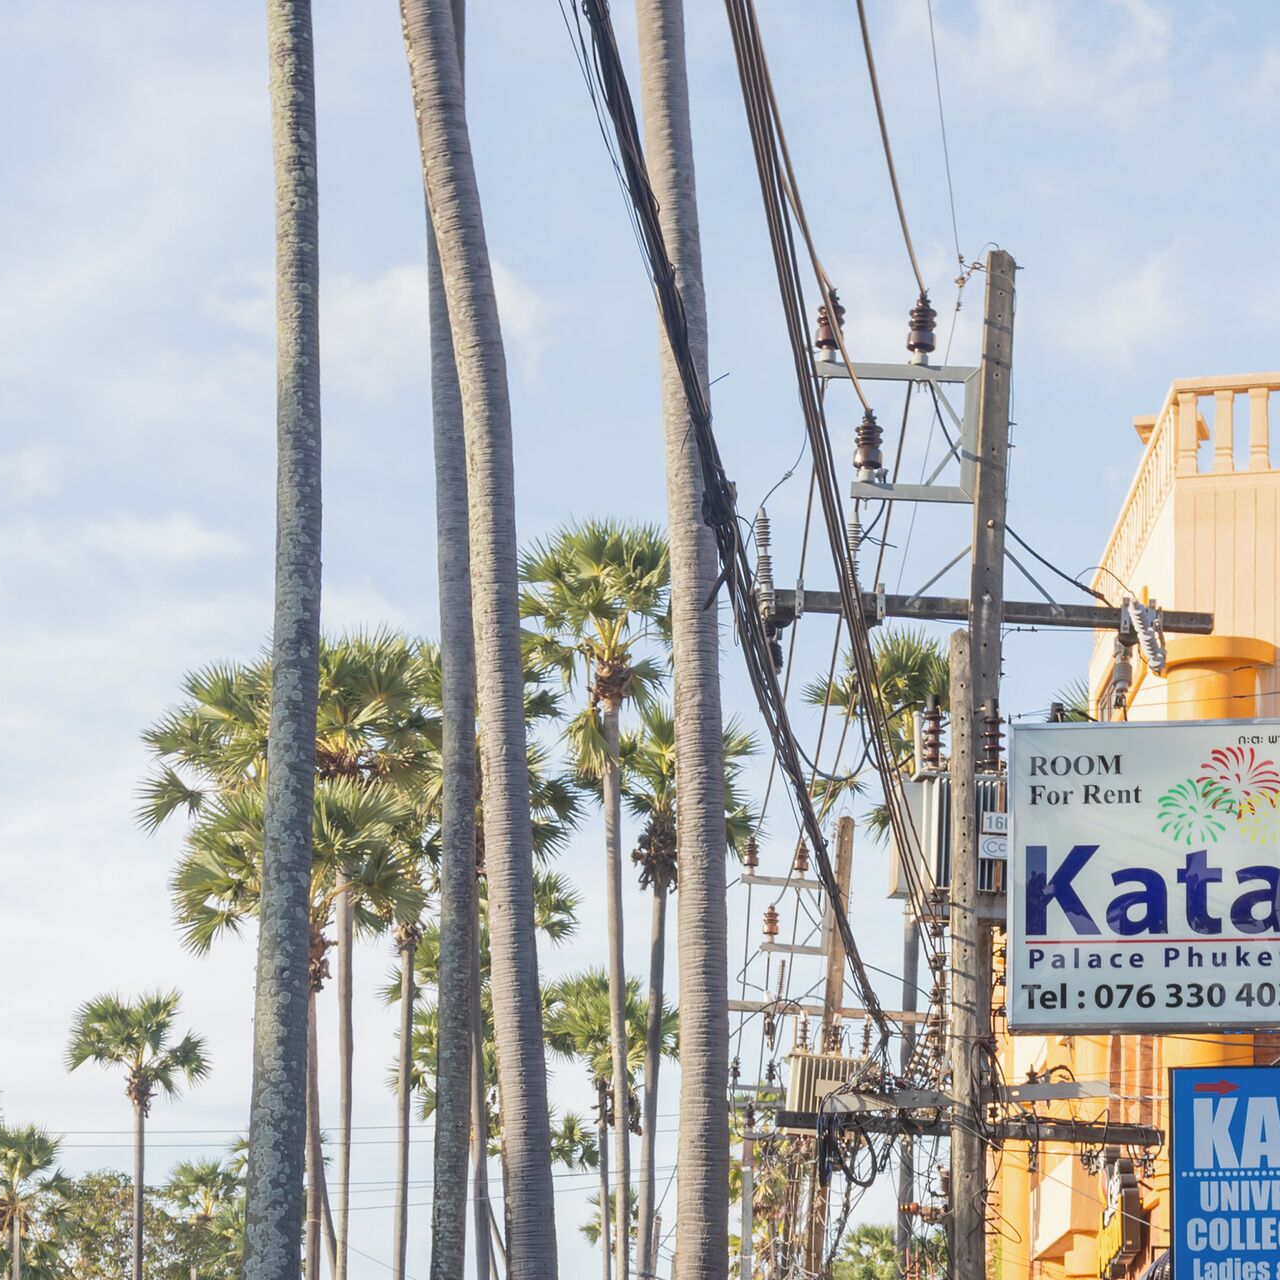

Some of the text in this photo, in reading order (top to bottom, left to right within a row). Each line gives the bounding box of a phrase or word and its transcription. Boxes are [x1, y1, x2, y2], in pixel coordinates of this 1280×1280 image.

[1029, 754, 1123, 777] ROOM
[1029, 783, 1142, 806] For Rent
[1029, 948, 1144, 969] Palace
[1094, 984, 1156, 1009] 076
[1165, 983, 1226, 1008] 330
